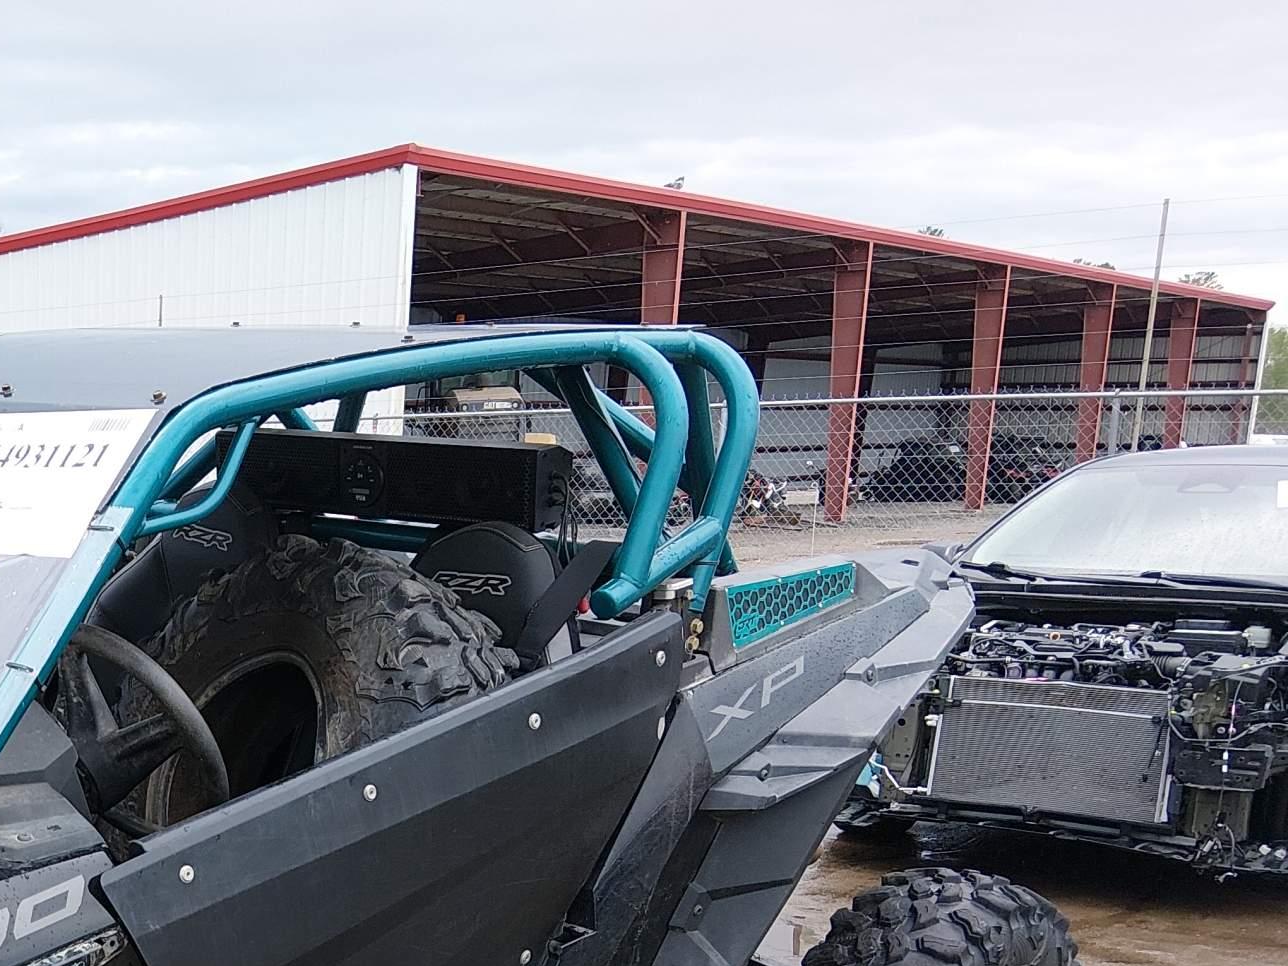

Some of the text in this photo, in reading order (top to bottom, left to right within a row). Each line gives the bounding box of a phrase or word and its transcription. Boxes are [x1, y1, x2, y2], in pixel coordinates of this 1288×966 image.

[173, 524, 233, 551] RZR
[432, 571, 512, 596] RZR
[706, 655, 805, 743] XP
